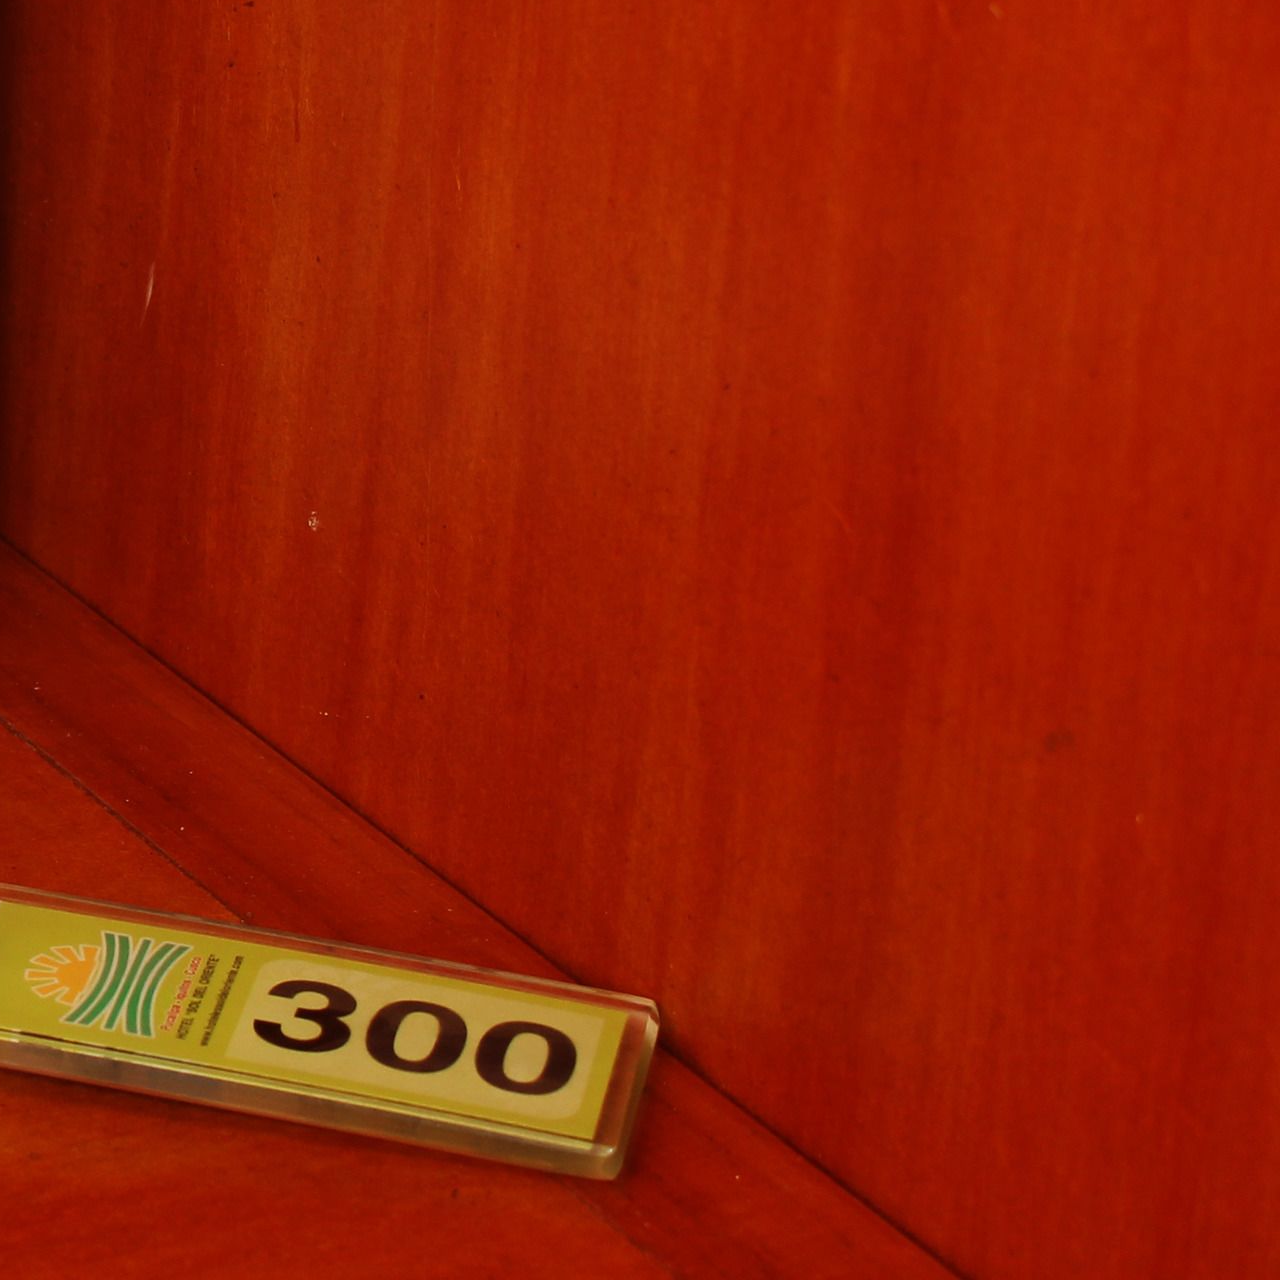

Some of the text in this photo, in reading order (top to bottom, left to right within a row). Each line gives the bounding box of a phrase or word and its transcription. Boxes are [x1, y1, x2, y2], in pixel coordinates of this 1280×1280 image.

[176, 1018, 194, 1040] HOTEL
[192, 985, 208, 999] DEL
[253, 979, 578, 1096] 300
